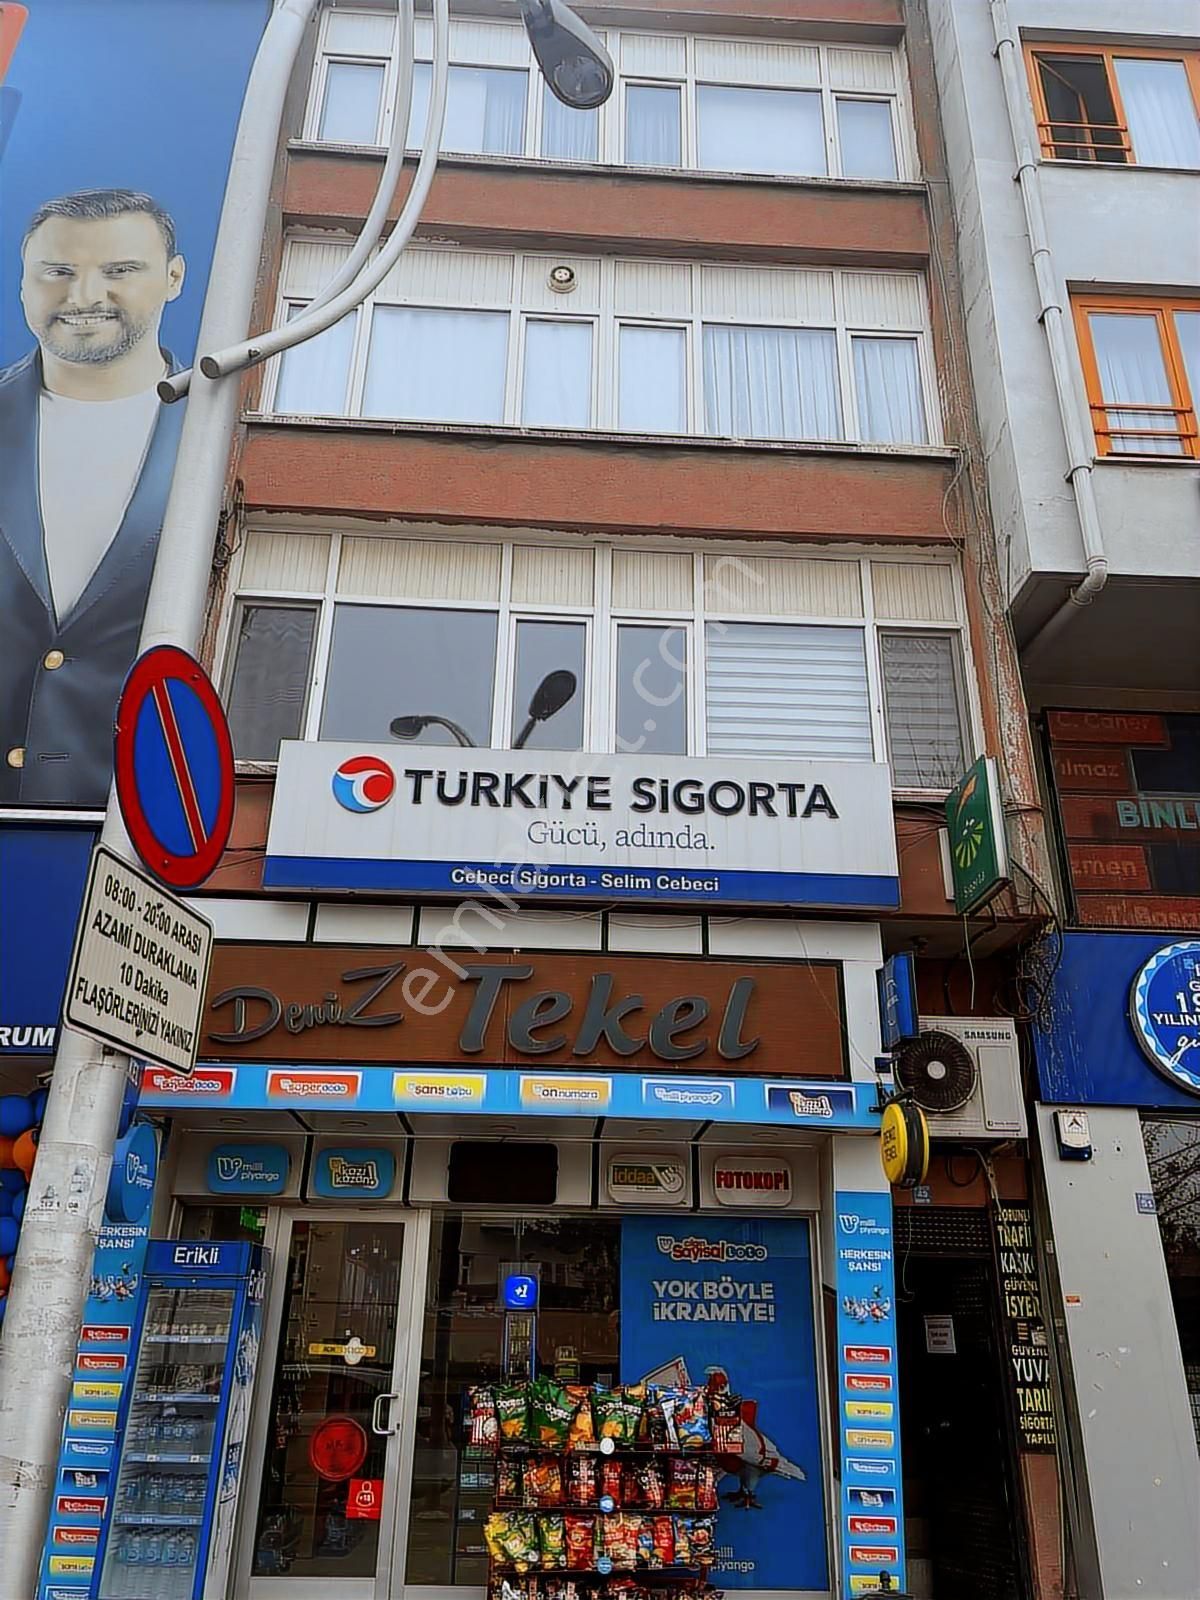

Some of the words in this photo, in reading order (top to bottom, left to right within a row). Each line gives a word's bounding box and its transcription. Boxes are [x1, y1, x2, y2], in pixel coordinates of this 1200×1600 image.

[527, 820, 606, 852] Gücü,
[615, 823, 715, 851] adında.
[451, 868, 515, 885] Cebeci
[520, 869, 586, 889] Sigorta
[601, 873, 651, 889] Selim
[656, 875, 719, 892] Cebeci
[105, 875, 135, 911] 08:00
[143, 902, 171, 936] 20:00
[171, 920, 202, 956] ARASI
[92, 909, 133, 949] AZAMİ
[133, 932, 197, 990] DURAKLAMA
[120, 962, 133, 987] 10
[134, 971, 168, 1006] Dakika
[459, 965, 759, 1060] Tekel
[1153, 1014, 1200, 1026] YILIN
[160, 1017, 193, 1053] YAKINIZ
[964, 1031, 1011, 1040] SAMSUNG
[614, 1168, 655, 1184] iddaa
[716, 1169, 789, 1191] FOTOKOPİ
[174, 1246, 219, 1264] Erikli
[653, 1280, 699, 1299] YOK
[703, 1276, 774, 1300] BÖYLE
